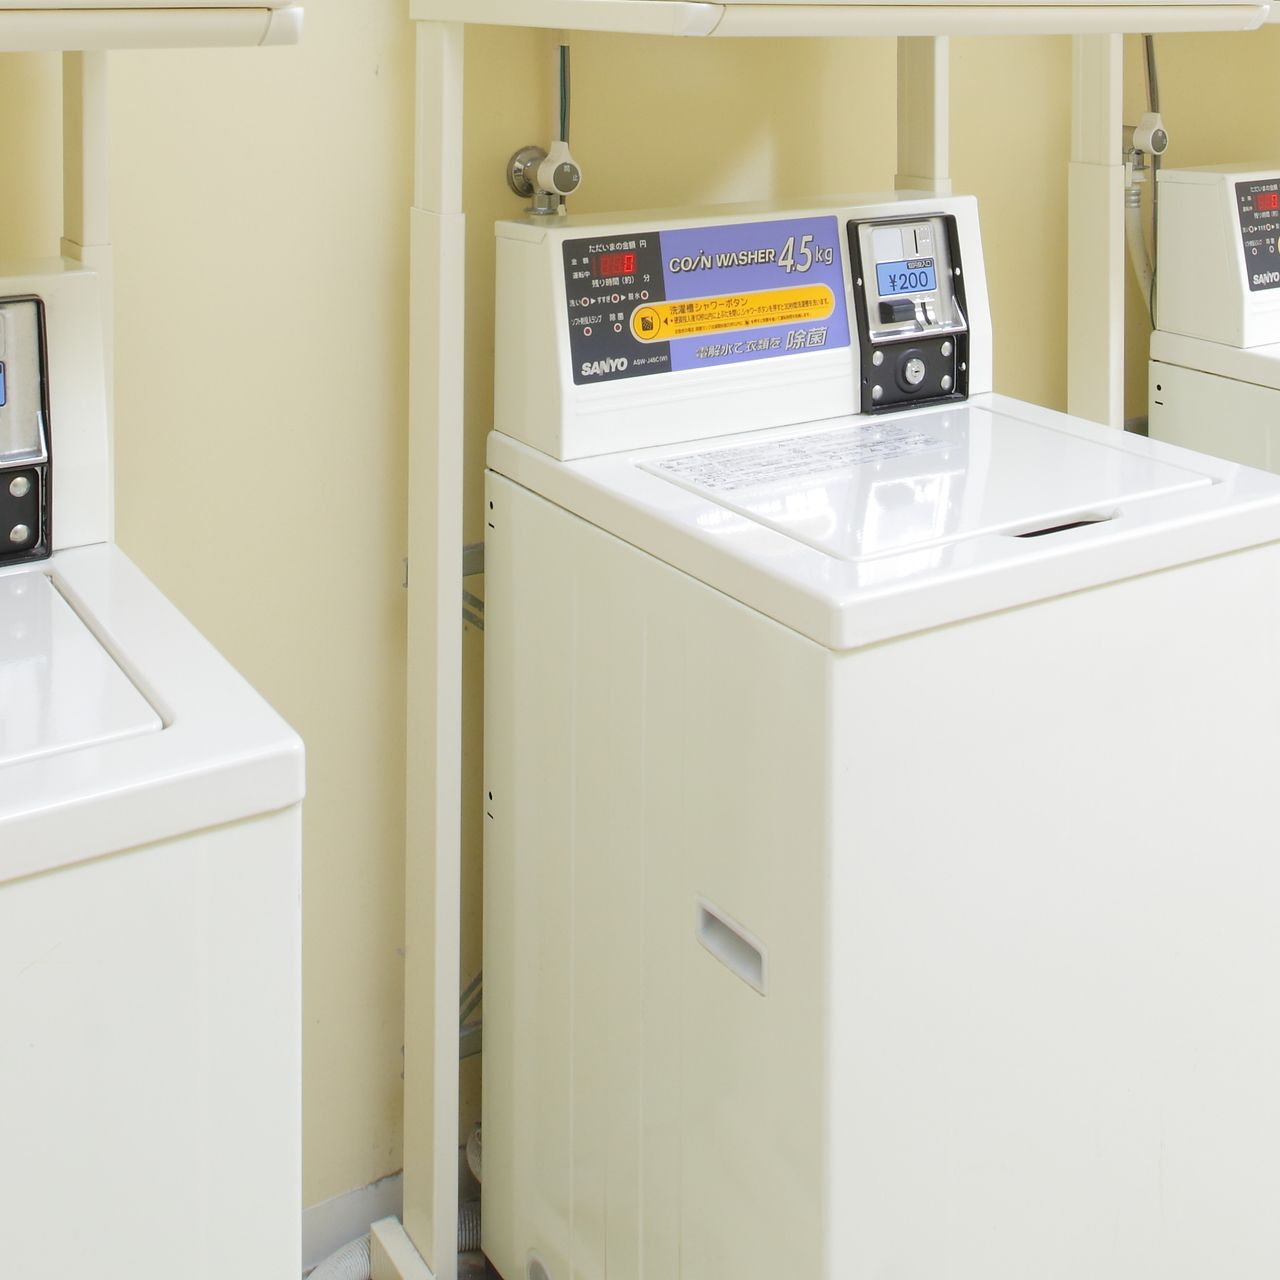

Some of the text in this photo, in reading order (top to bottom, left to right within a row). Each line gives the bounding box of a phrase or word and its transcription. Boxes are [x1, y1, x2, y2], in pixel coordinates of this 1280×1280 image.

[716, 248, 776, 269] WASHER
[889, 271, 928, 291] ¥200
[1253, 271, 1280, 285] SANYO
[786, 327, 829, 350] 除菌
[581, 356, 628, 376] SANYO
